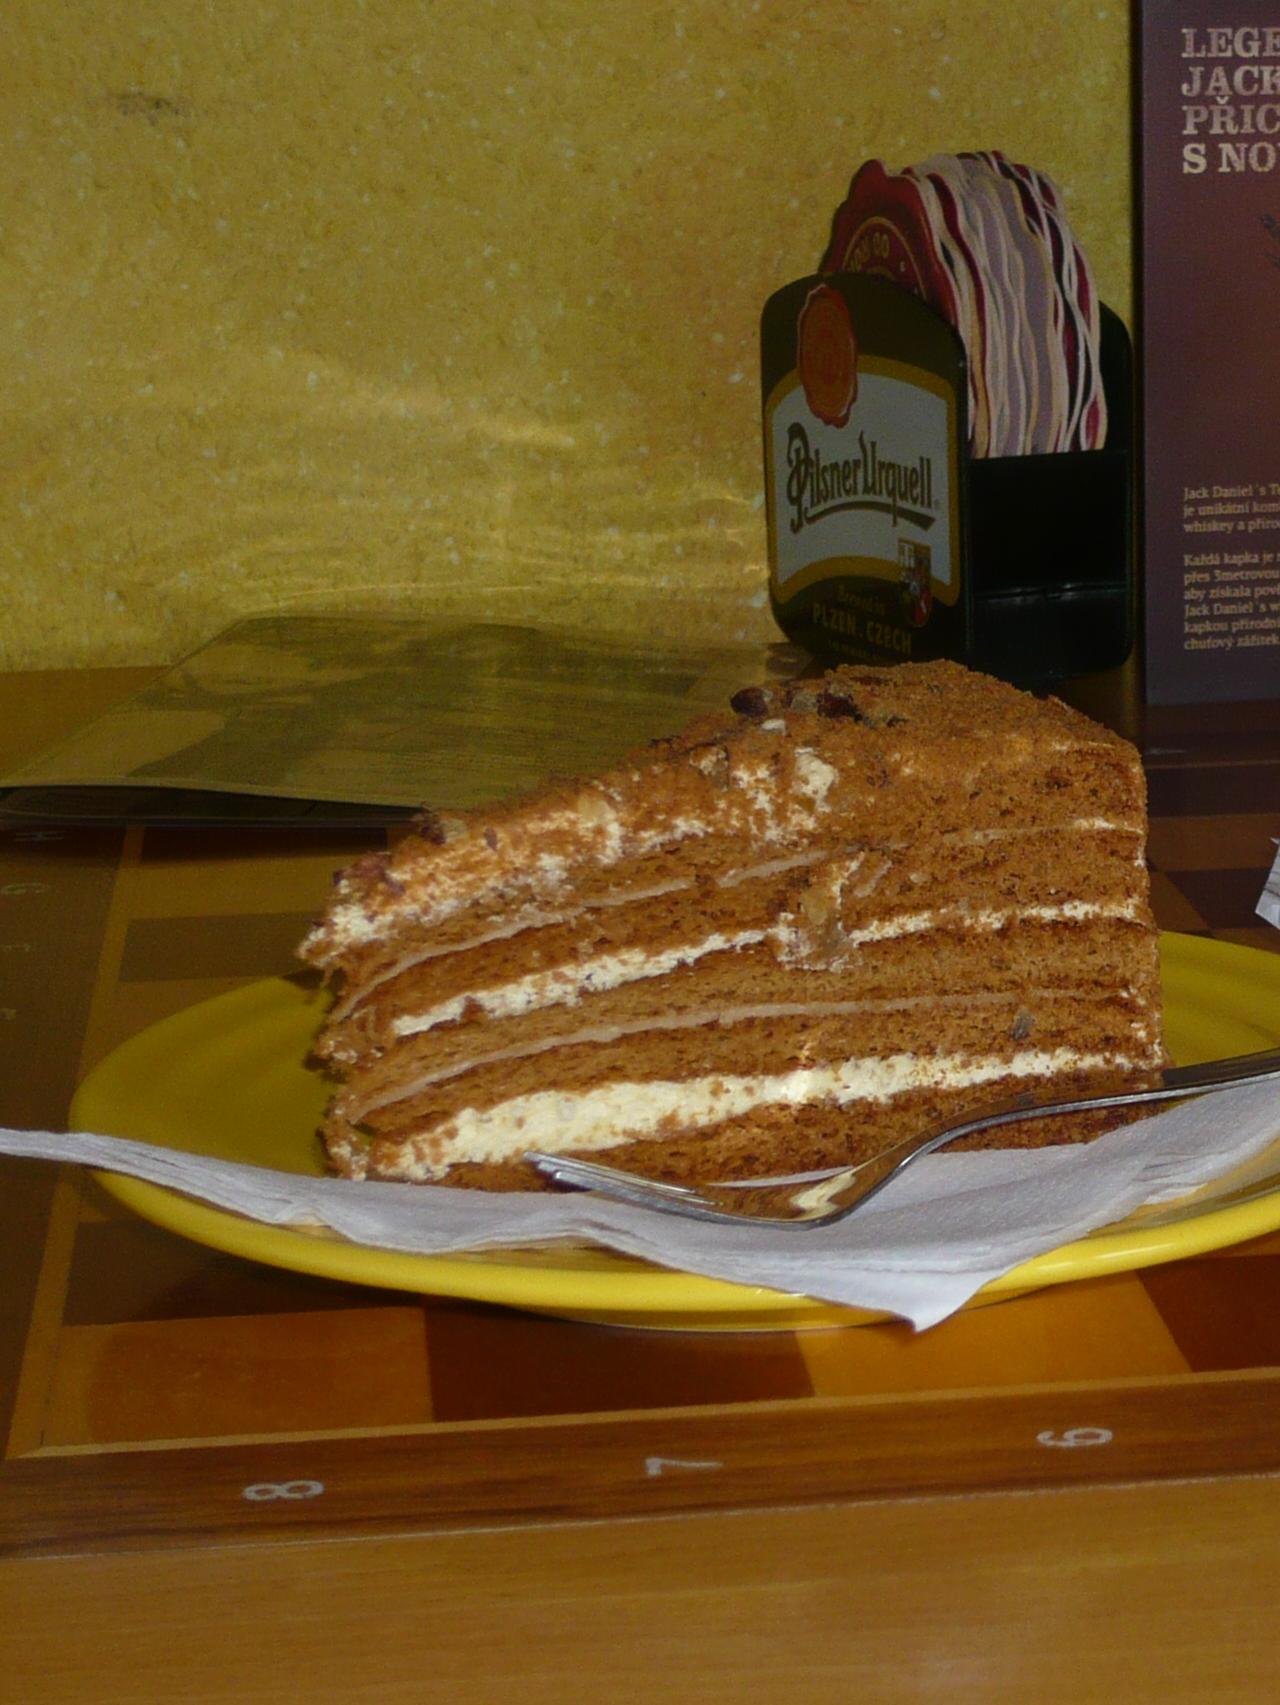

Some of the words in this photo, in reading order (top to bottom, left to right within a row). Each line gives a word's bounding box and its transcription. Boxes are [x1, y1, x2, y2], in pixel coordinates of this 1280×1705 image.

[1181, 144, 1208, 174] S
[786, 422, 860, 534] Pilsner
[858, 431, 933, 527] Urquell
[1184, 487, 1210, 500] Jack
[1212, 485, 1253, 498] Daniel
[1183, 520, 1234, 534] whiskey
[1223, 552, 1259, 566] kapka
[1183, 588, 1206, 602] aby
[1184, 603, 1211, 617] Jack
[1184, 619, 1228, 634] kapkou
[645, 1457, 722, 1476] 7
[244, 1479, 324, 1500] 8
